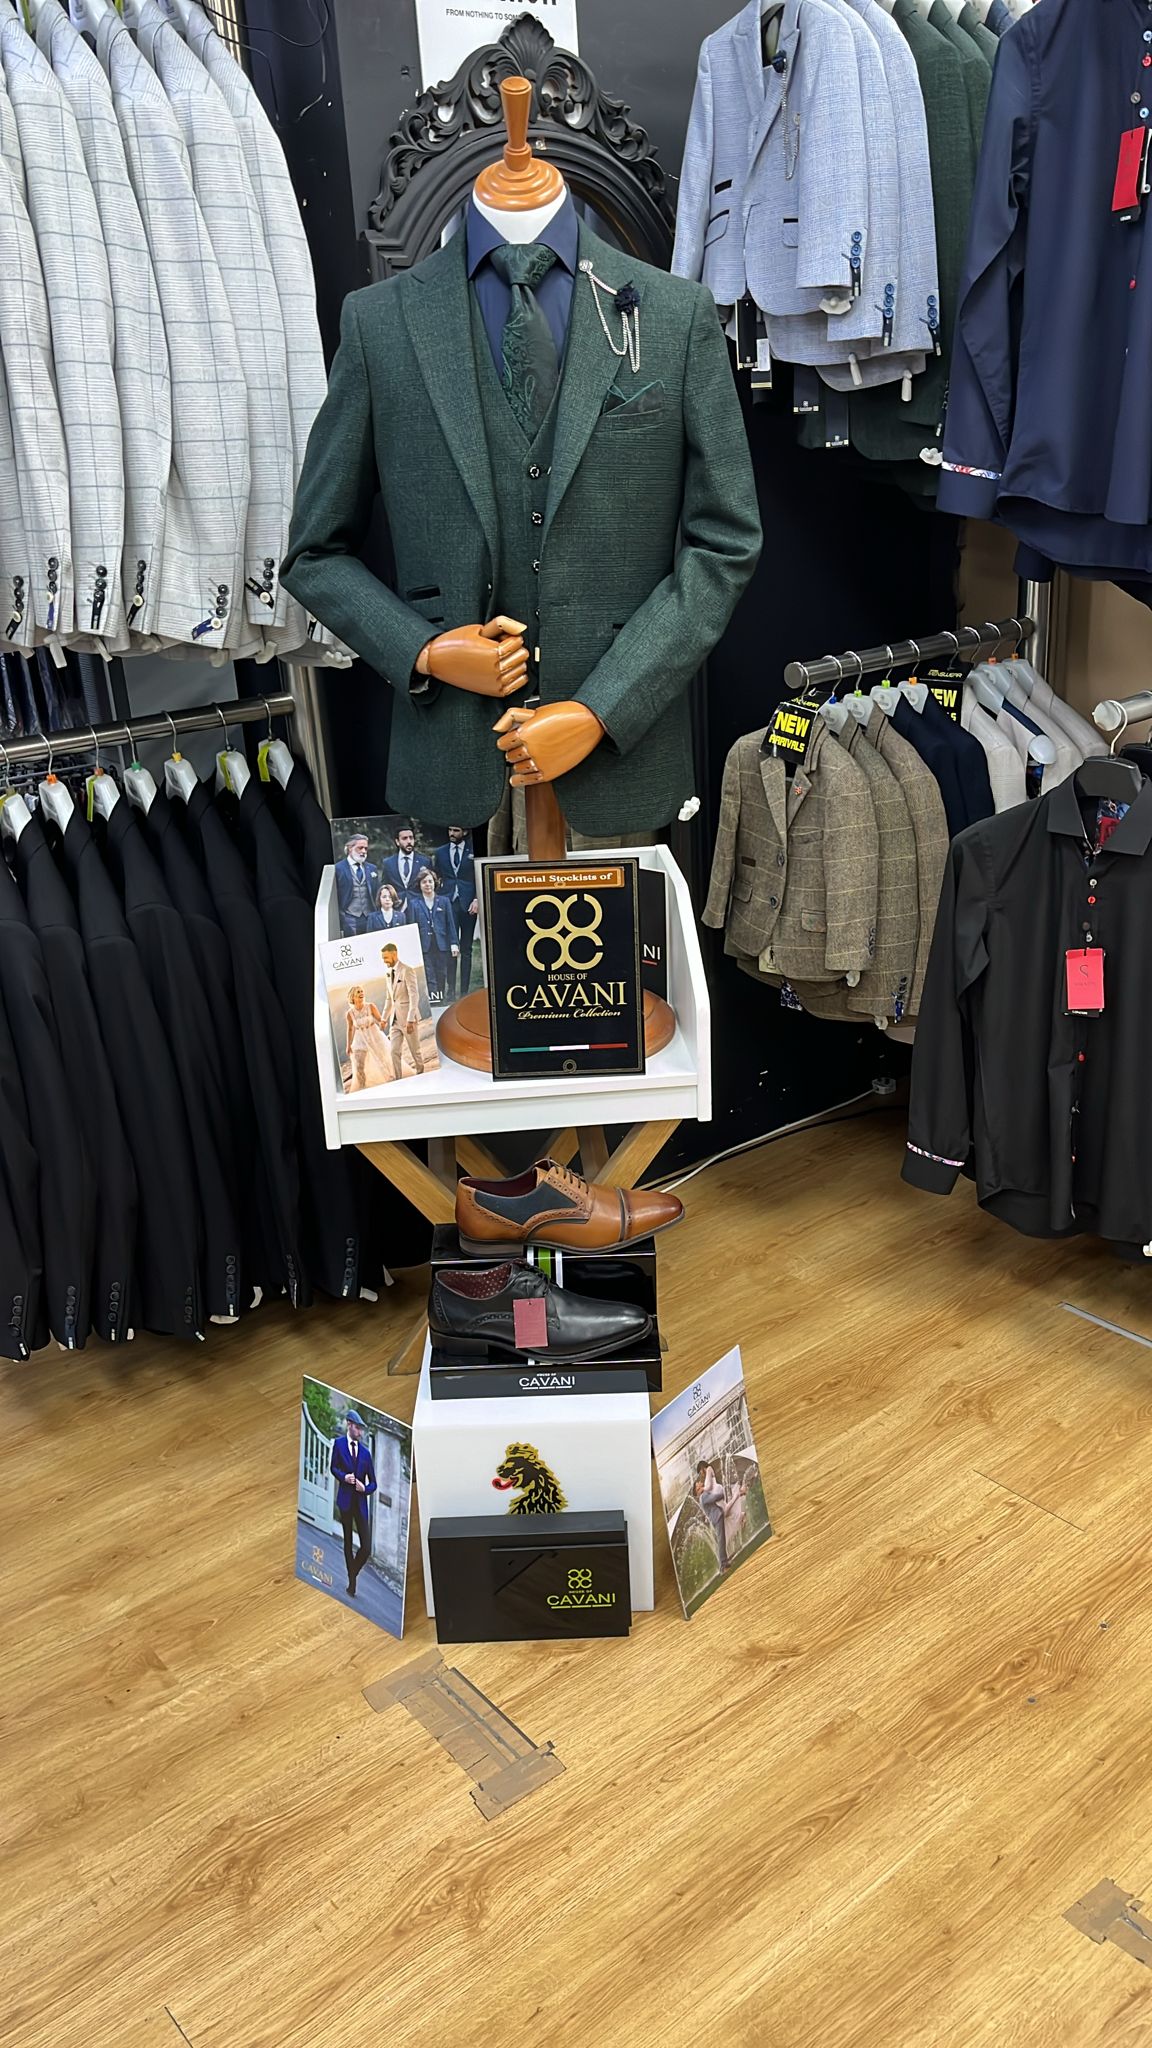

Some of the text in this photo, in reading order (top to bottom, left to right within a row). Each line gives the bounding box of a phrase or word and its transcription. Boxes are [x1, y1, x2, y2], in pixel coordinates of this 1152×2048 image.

[445, 8, 465, 17] FROM
[466, 10, 494, 20] NOTHING
[495, 12, 504, 20] TO
[930, 688, 958, 708] EW
[773, 711, 811, 738] NEW
[768, 734, 806, 753] ARRIVALS
[504, 872, 614, 884] Official Stockists of
[332, 957, 365, 969] CAVANI
[547, 972, 588, 982] HOUSE OF
[506, 981, 628, 1010] CAVANI
[517, 1005, 621, 1020] Premium Collection
[518, 1376, 576, 1387] CAVANI
[687, 1392, 711, 1417] CAVANI
[546, 1593, 616, 1606] CAVANI
